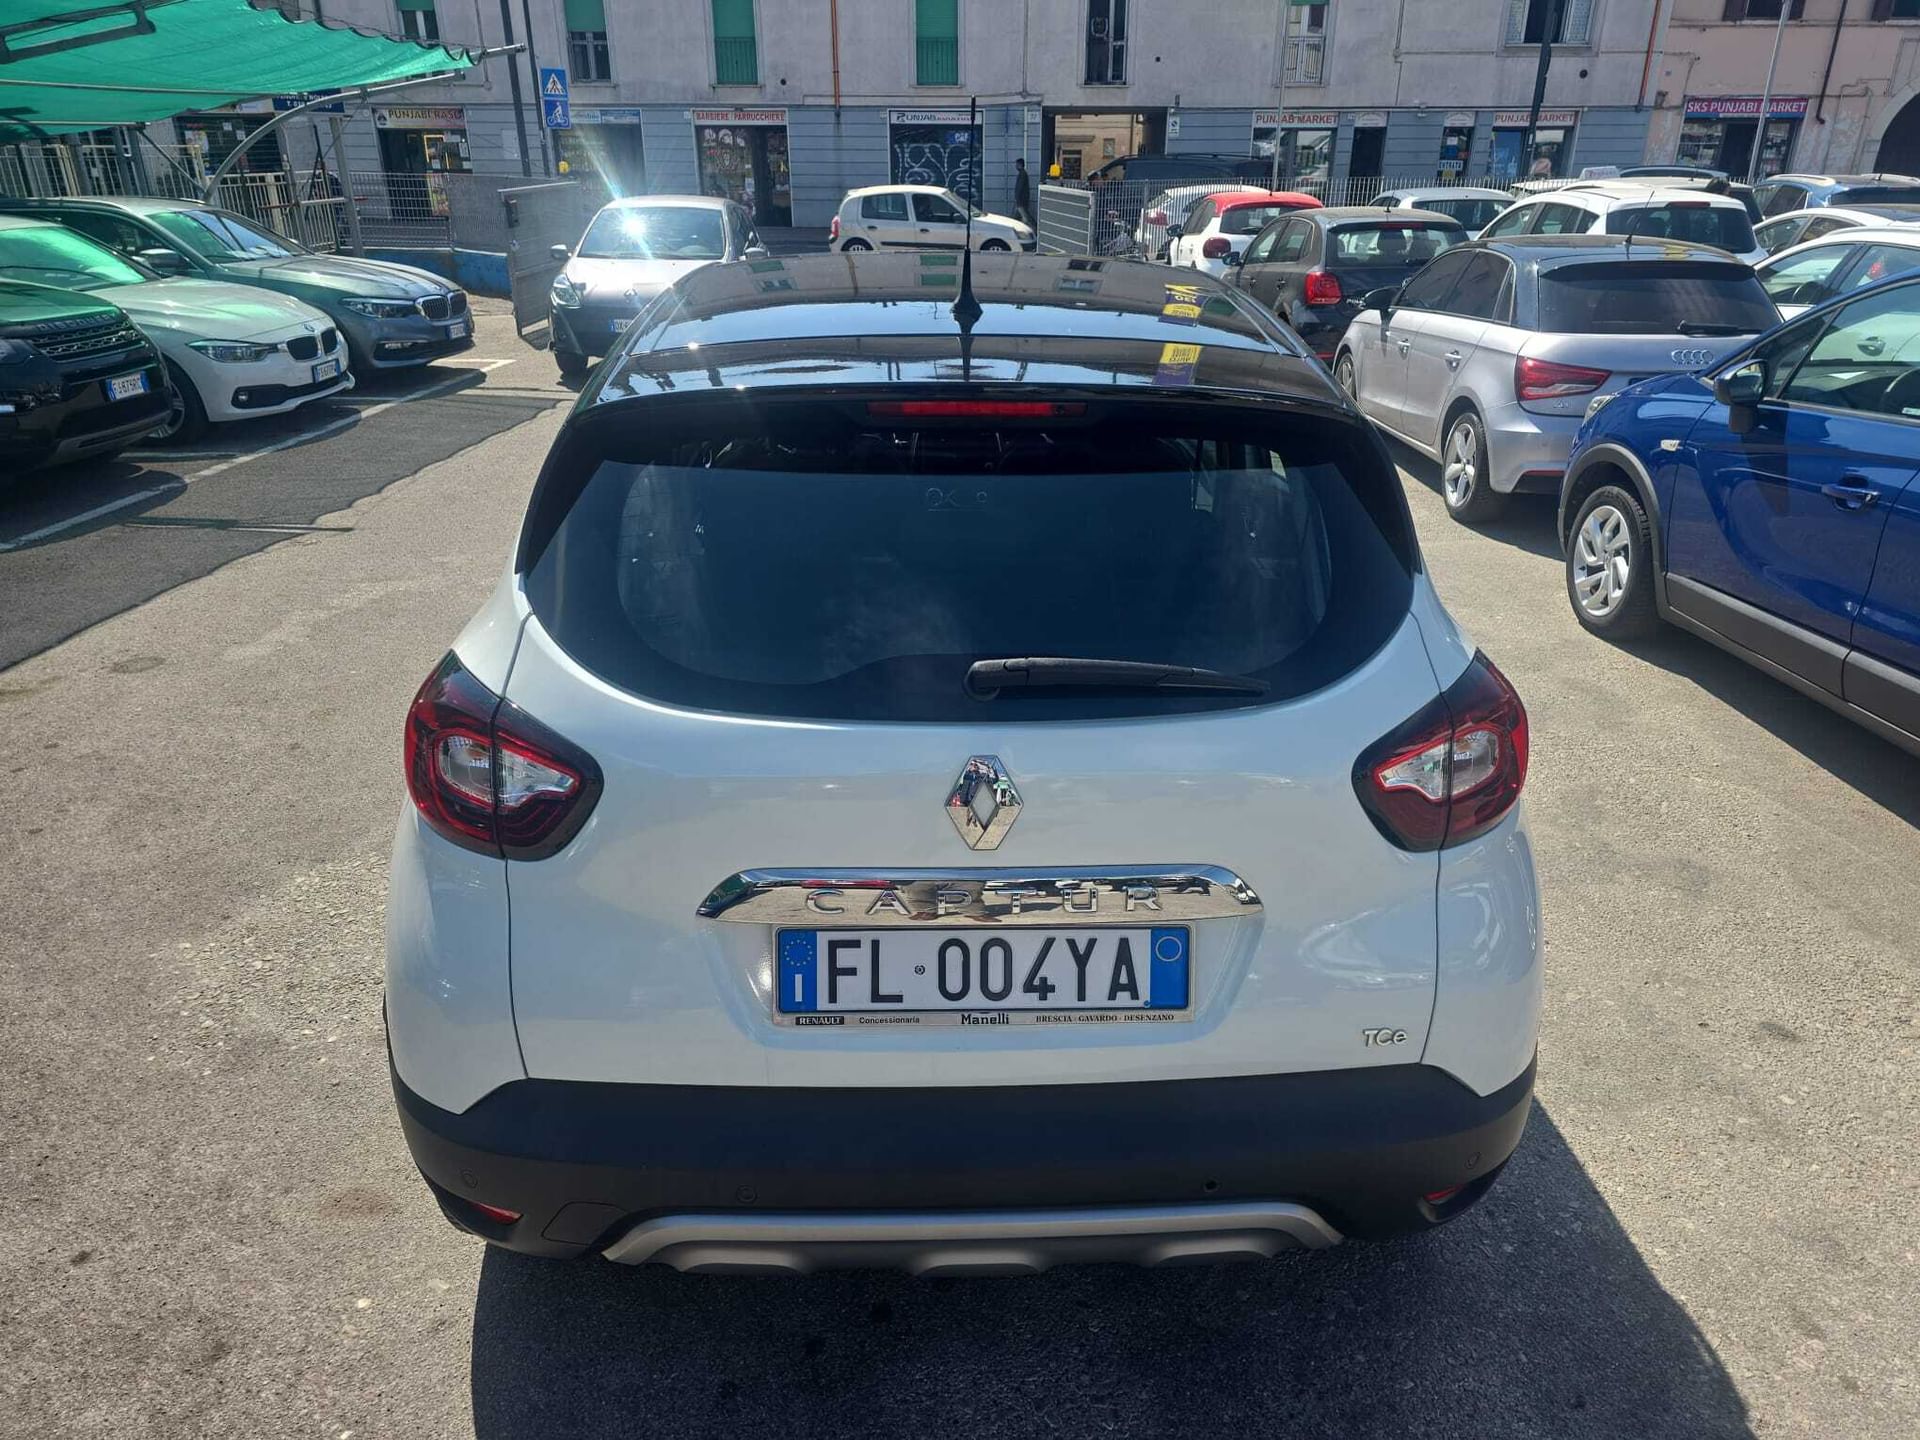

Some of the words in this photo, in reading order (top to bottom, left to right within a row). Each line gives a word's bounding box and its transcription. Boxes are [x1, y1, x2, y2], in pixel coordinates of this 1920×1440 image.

[1687, 101, 1708, 112] SKS
[1710, 101, 1757, 113] PUNJABI
[389, 110, 433, 119] PUNJABI
[734, 111, 785, 120] PARRUCCHIERE
[1298, 113, 1338, 124] MARKET
[806, 886, 1162, 915] CAPTUR
[828, 939, 904, 1004] FL
[798, 1016, 841, 1025] RENAULT
[858, 1016, 920, 1025] Concessionaria
[961, 1013, 1009, 1025] Manelli
[1036, 1014, 1073, 1023] BRESCIA
[1078, 1014, 1118, 1023] GAVARDO
[1123, 1013, 1175, 1022] DESENZANO
[1363, 1027, 1408, 1047] TCe
